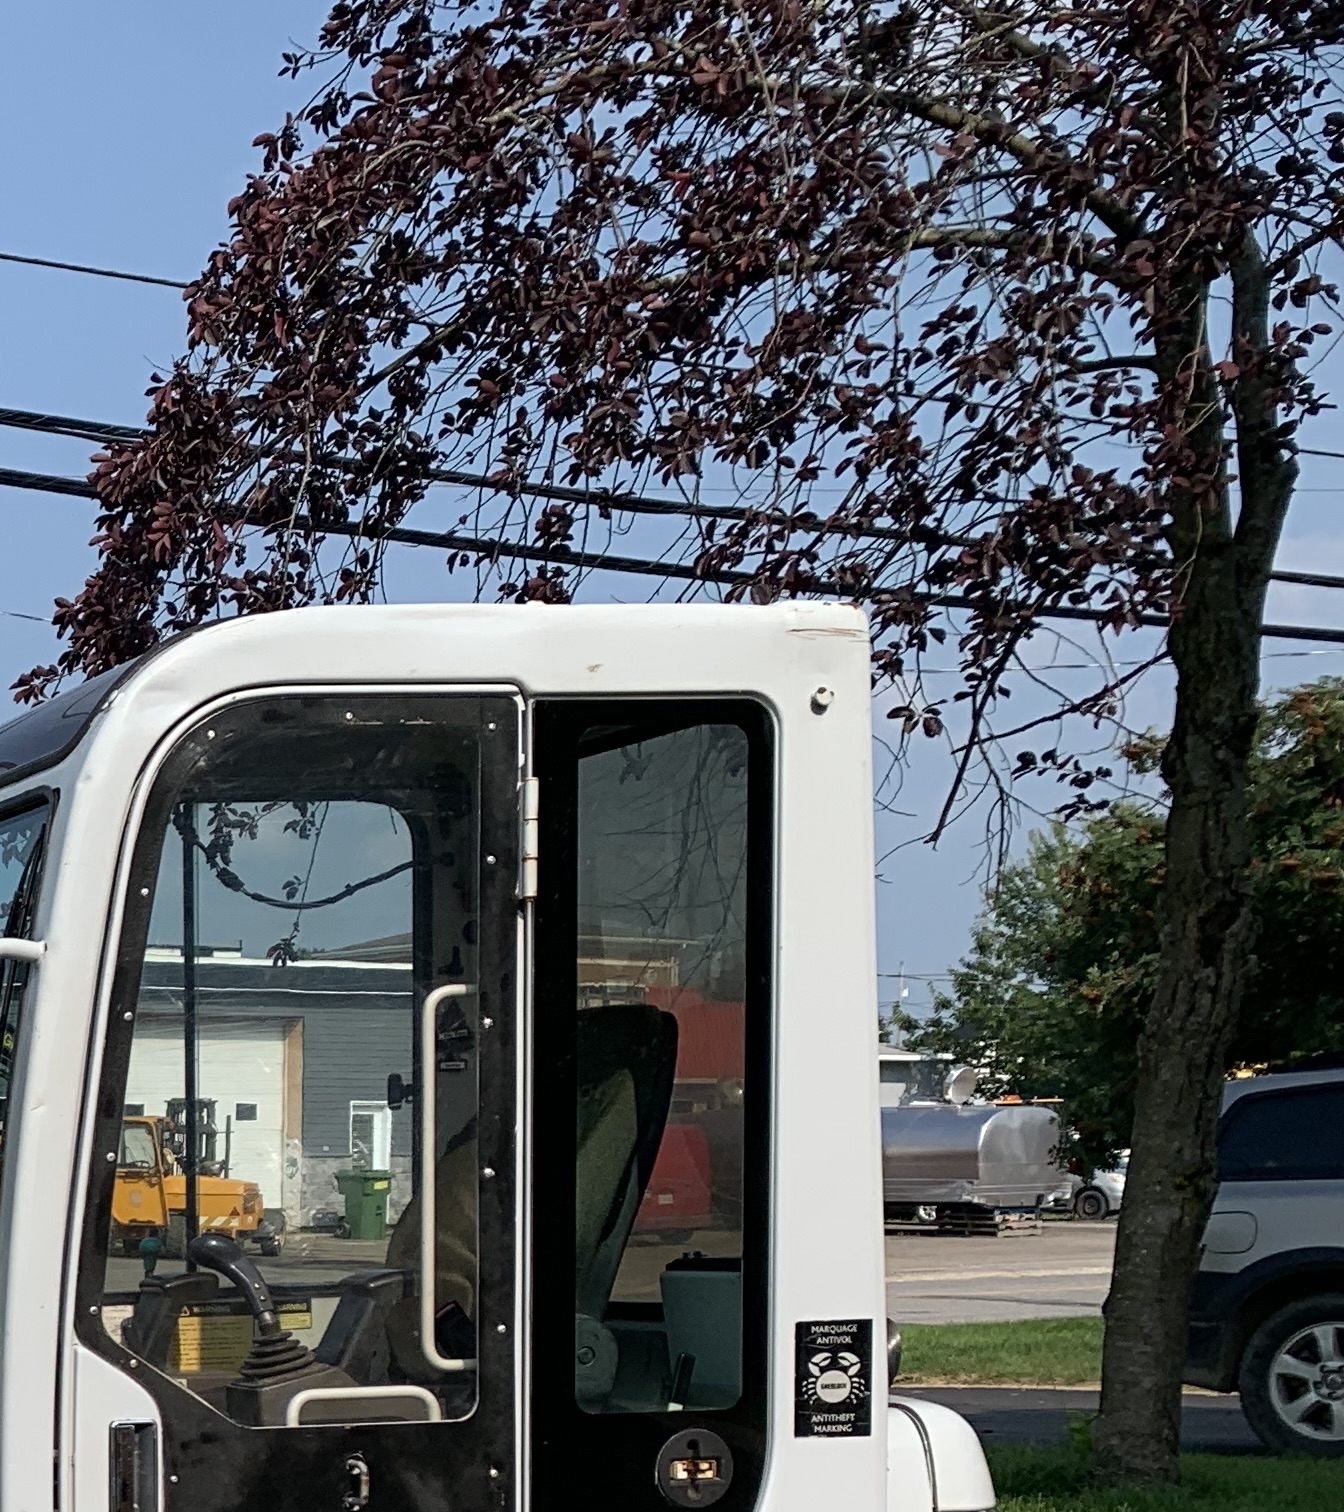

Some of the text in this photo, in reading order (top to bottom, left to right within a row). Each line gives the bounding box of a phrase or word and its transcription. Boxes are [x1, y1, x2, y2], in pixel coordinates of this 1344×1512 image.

[811, 1323, 858, 1334] MARQUAGE
[816, 1335, 852, 1344] ANTIVOL
[811, 1413, 856, 1423] ANTITHEFT
[814, 1424, 852, 1433] MARKING
